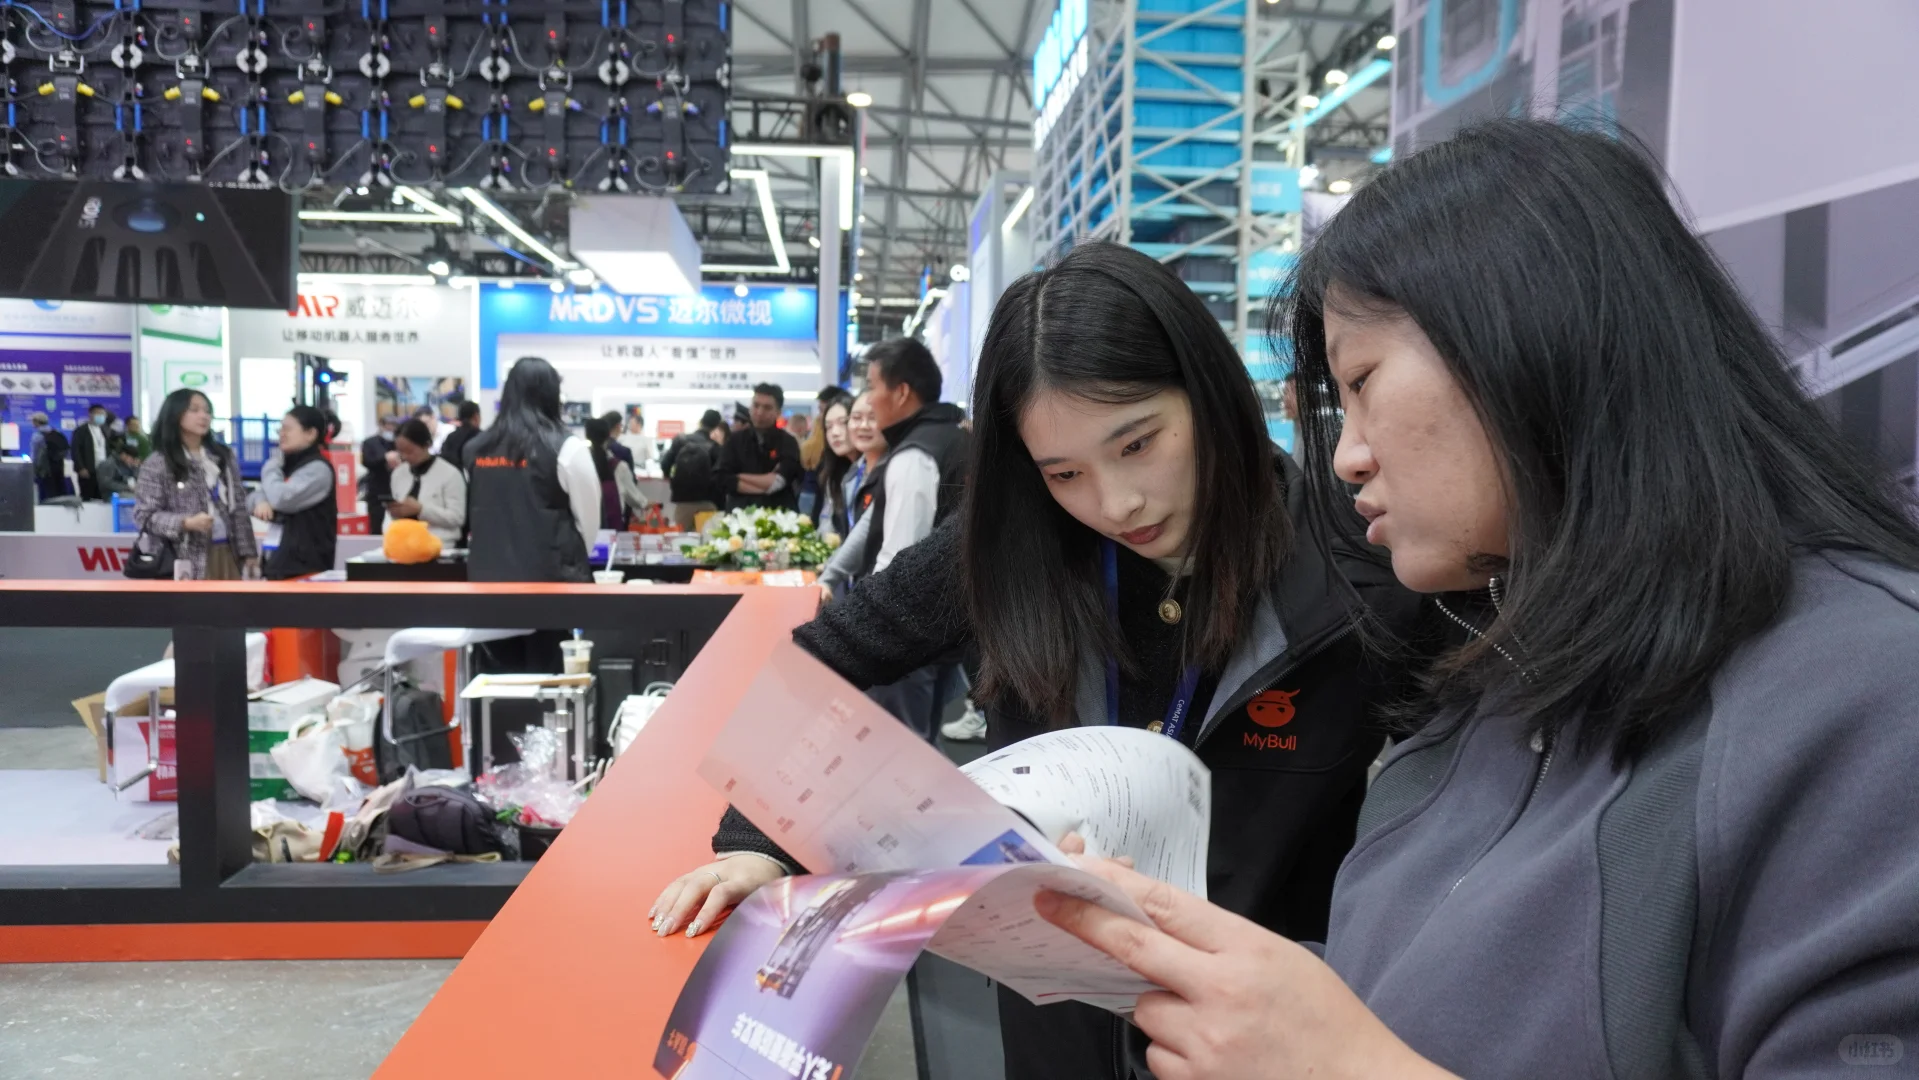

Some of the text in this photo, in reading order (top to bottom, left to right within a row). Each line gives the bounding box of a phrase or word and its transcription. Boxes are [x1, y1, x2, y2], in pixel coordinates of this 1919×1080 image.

[668, 297, 774, 326] 迈尔微视
[1172, 699, 1185, 724] CeMAT
[1243, 732, 1297, 750] MyBull
